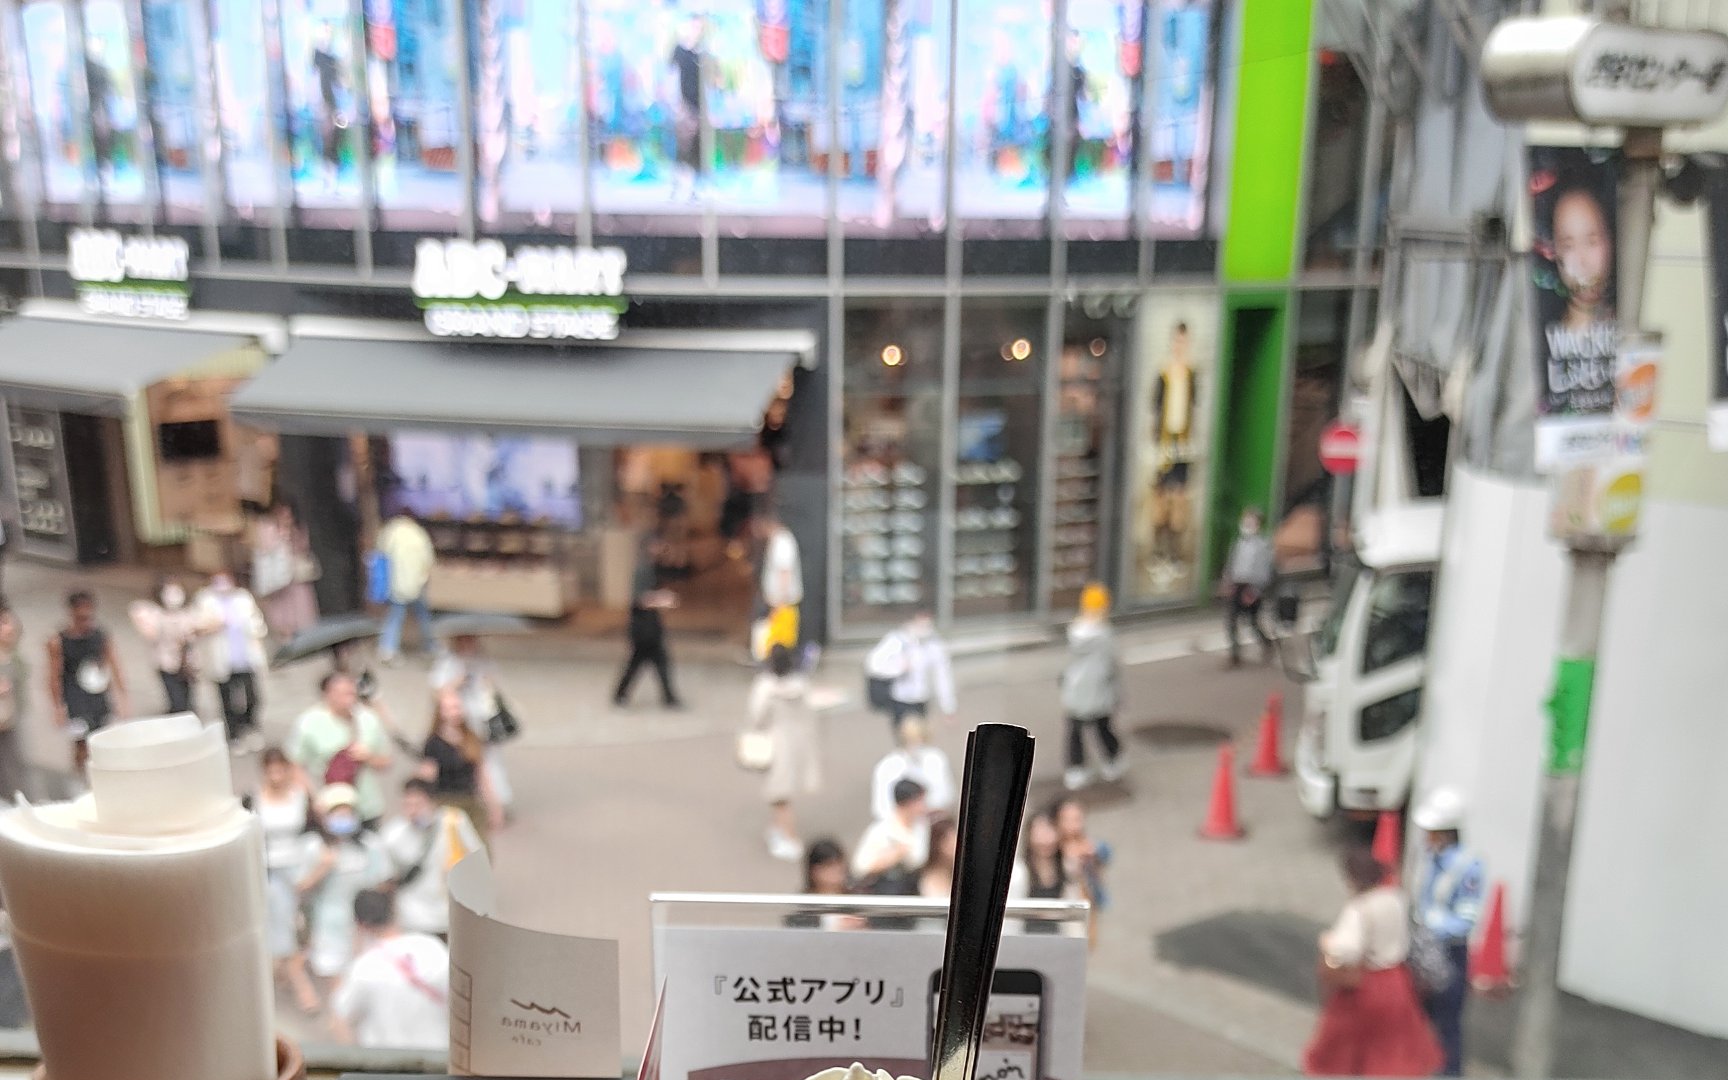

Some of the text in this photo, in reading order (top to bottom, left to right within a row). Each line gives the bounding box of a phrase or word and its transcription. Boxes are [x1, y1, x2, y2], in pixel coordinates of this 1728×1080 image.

[714, 975, 902, 1007] 『公式アプリ』
[748, 1014, 862, 1042] 配信中!
